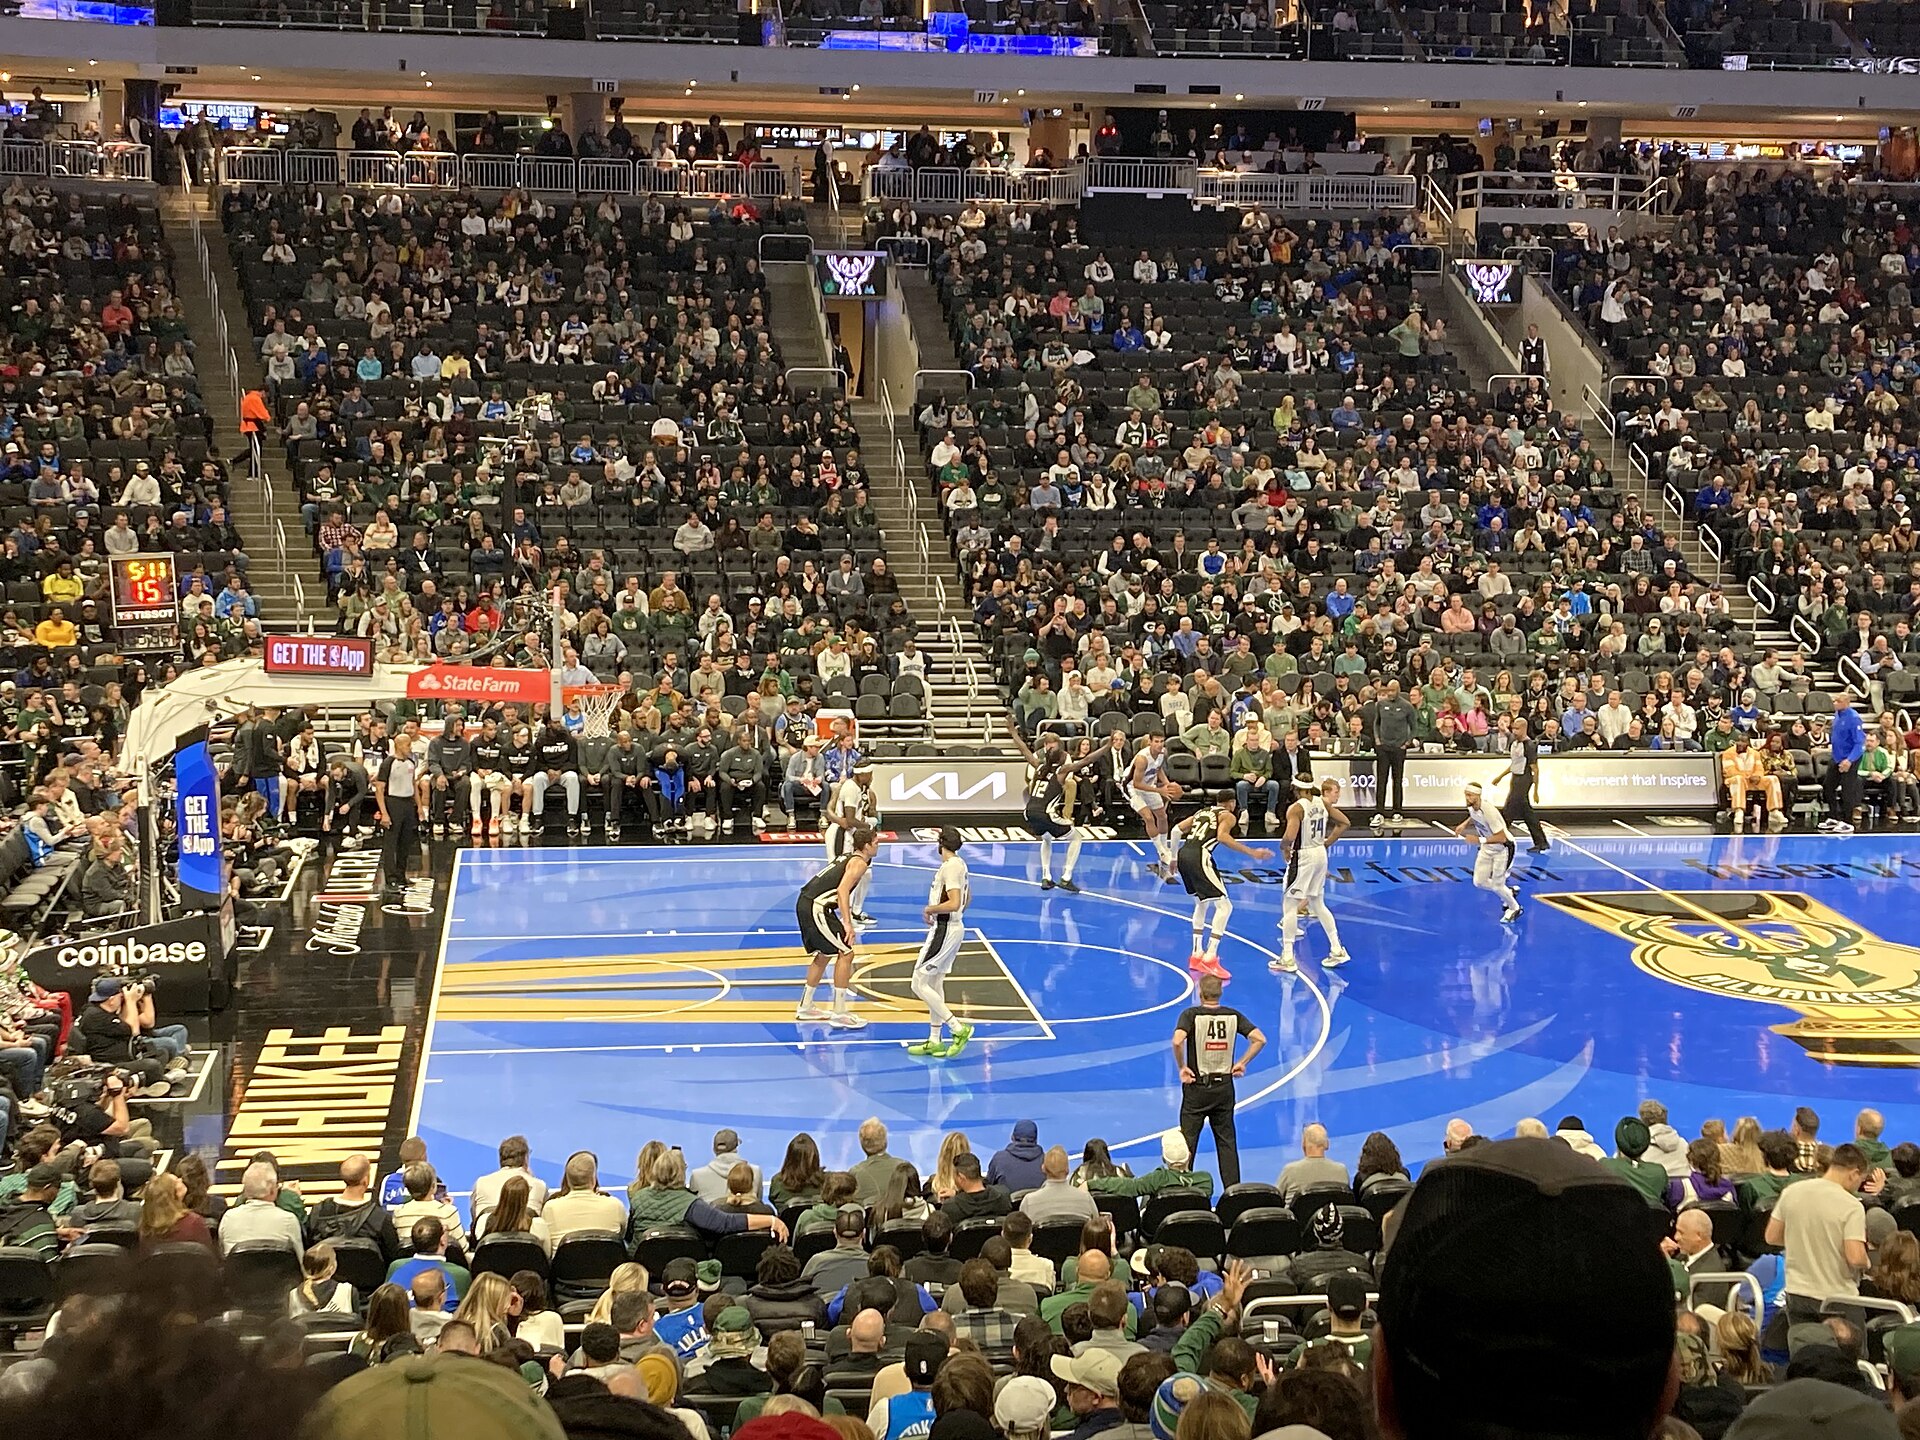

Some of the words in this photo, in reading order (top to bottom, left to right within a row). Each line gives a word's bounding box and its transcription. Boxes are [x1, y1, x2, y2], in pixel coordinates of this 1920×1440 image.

[596, 81, 615, 92] 116
[977, 92, 995, 103] 117
[1304, 99, 1322, 110] 117
[137, 580, 160, 602] 15
[133, 609, 175, 619] TISSOT
[273, 642, 299, 665] GET
[302, 643, 327, 666] THE
[341, 645, 365, 671] App
[1031, 780, 1049, 799] 12
[1632, 774, 1656, 787] that
[1660, 774, 1707, 789] inspires
[184, 795, 209, 815] GET
[185, 814, 211, 834] THE
[957, 826, 1037, 841] NBA
[1187, 821, 1209, 840] 34
[1310, 817, 1324, 839] 34
[193, 834, 215, 857] App
[323, 848, 383, 893] ULTRA
[305, 902, 367, 956] Michelob
[57, 937, 207, 968] coinbase
[1690, 973, 1913, 1004] MILWAUKEE
[1207, 1020, 1227, 1039] 48
